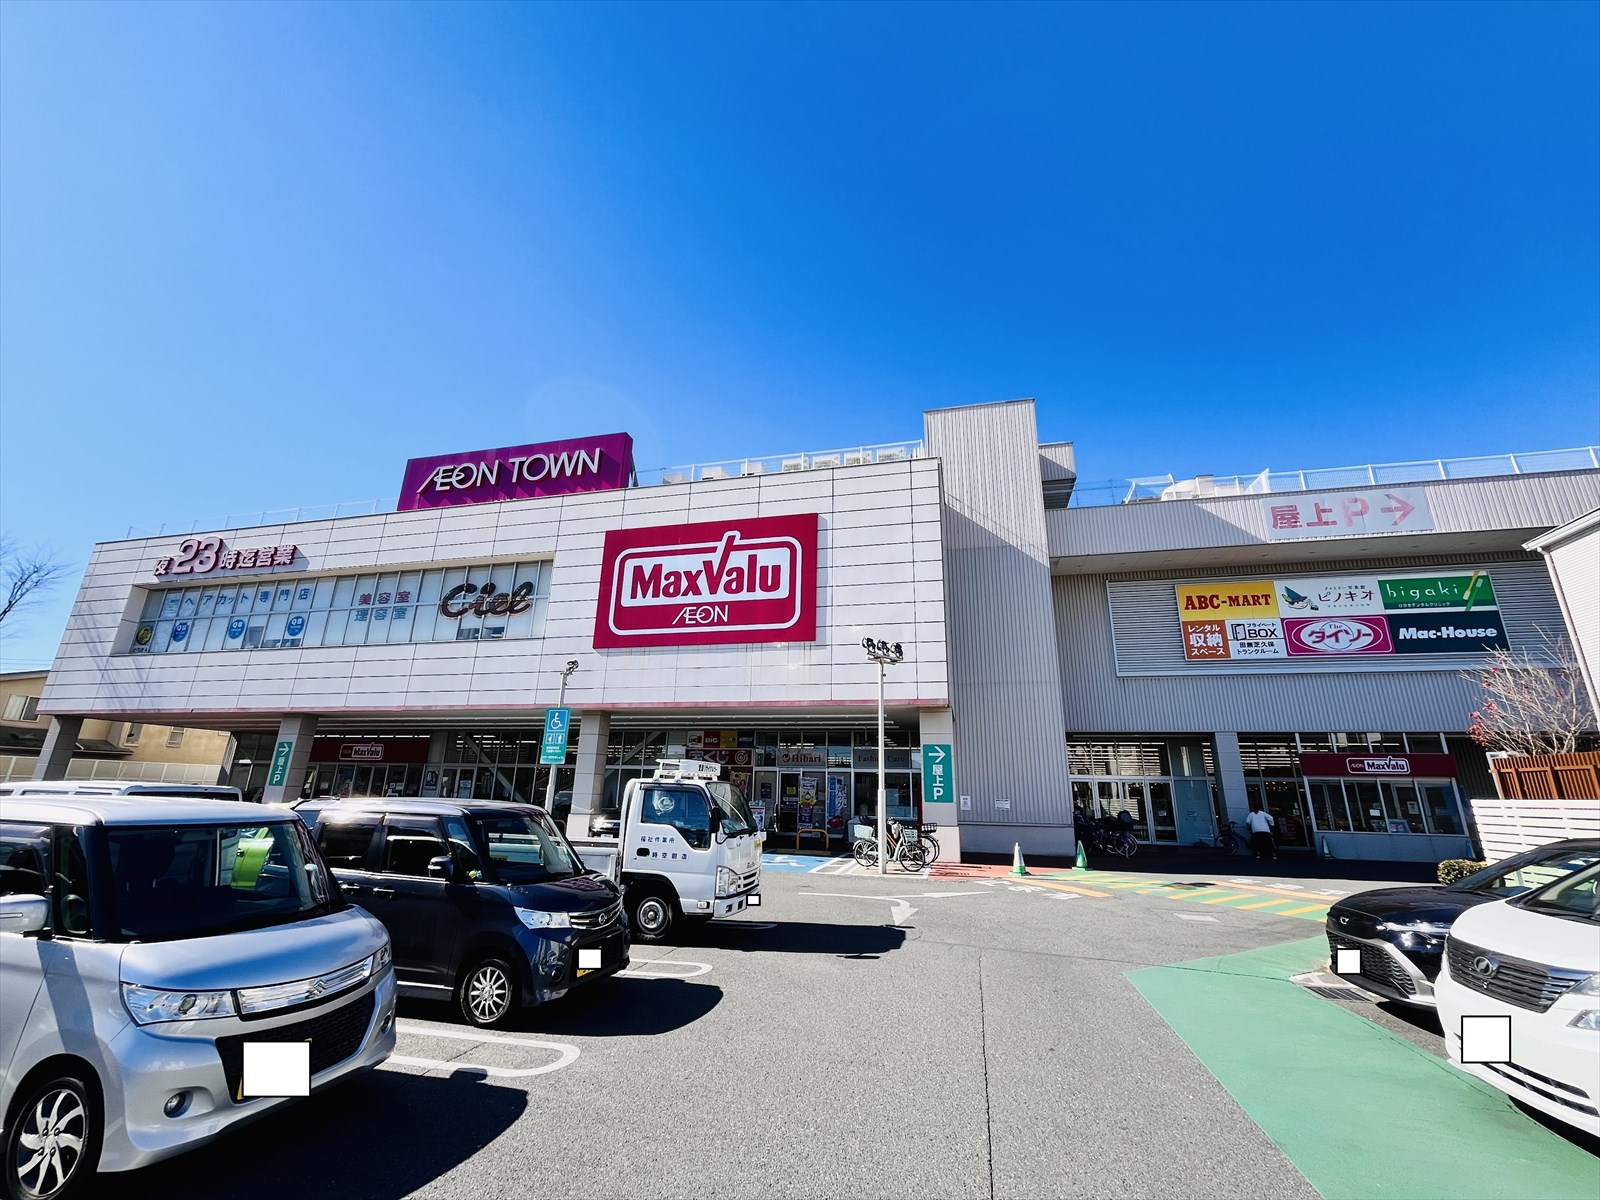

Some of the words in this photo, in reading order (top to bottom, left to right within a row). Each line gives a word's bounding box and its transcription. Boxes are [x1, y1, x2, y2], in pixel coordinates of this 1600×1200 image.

[508, 447, 601, 483] TOWN
[1271, 497, 1370, 530] 屋上P
[630, 535, 781, 600] MaxValu
[184, 588, 311, 606] ヘアカット専門店
[1318, 590, 1374, 602] ピノキオ
[1386, 581, 1459, 600] higaki
[358, 591, 411, 606] 美容室
[439, 581, 534, 619] Ciel
[1184, 594, 1271, 611] ABC-MART
[354, 607, 408, 622] 理容室
[1188, 624, 1221, 632] レンタル
[1247, 628, 1279, 638] BOX
[1398, 626, 1498, 640] Mac-House
[1189, 632, 1224, 647] 収納
[1308, 628, 1372, 644] ダイソー
[1191, 648, 1226, 656] スペース
[792, 754, 821, 763] Hibari
[1367, 757, 1405, 770] MaxValu
[932, 764, 944, 800] 屋上P
